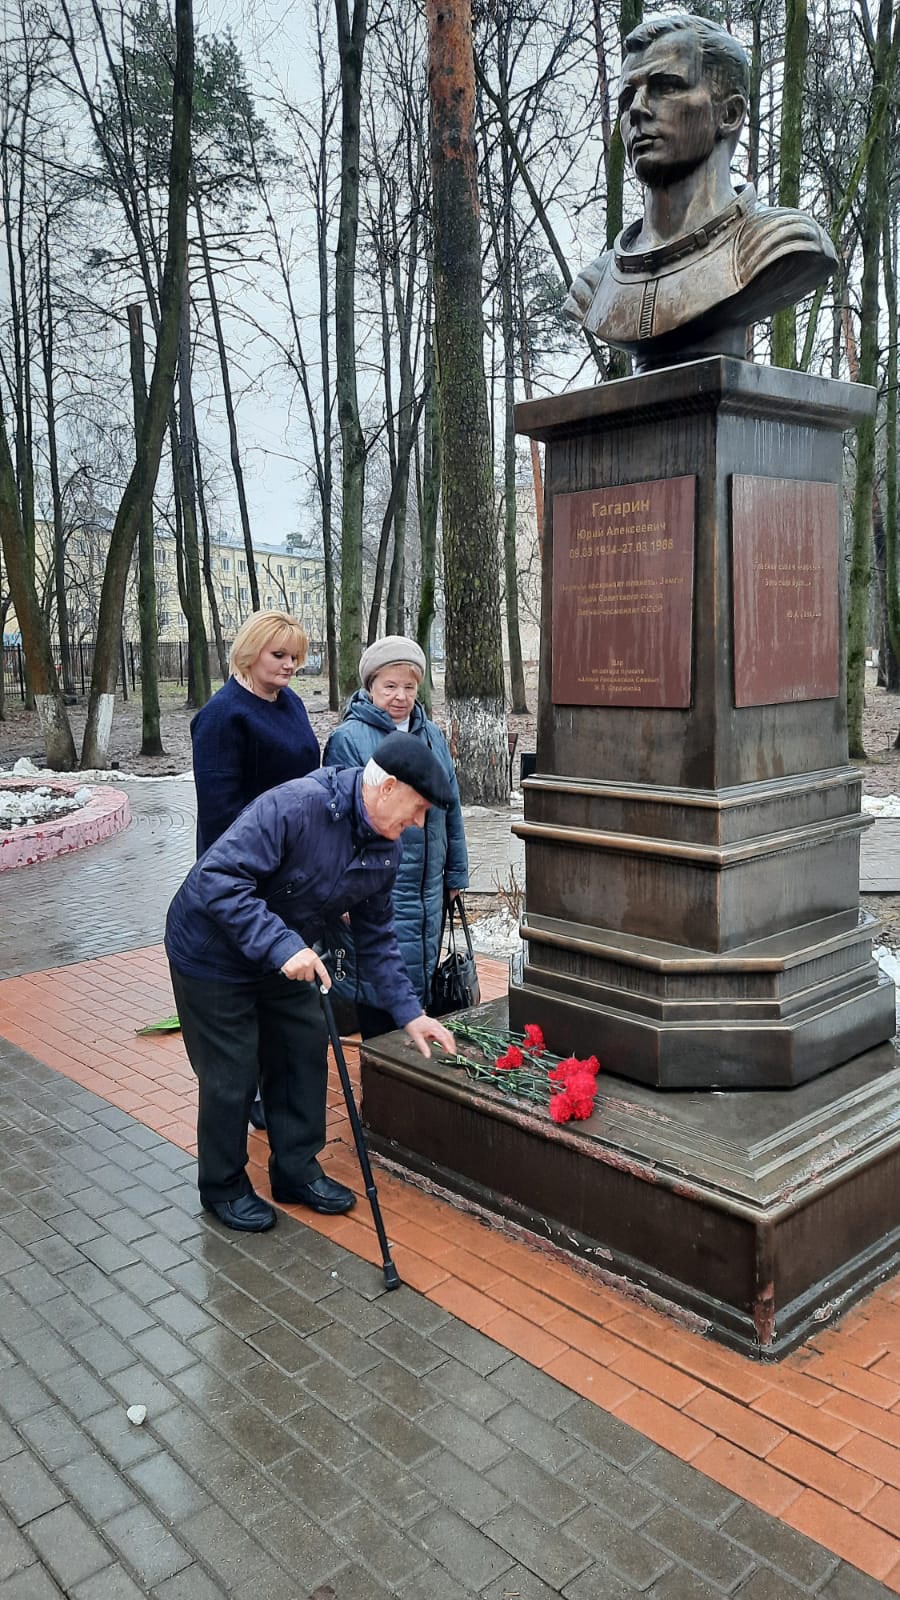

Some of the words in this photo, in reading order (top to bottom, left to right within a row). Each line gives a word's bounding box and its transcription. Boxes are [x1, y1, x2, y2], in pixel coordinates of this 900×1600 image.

[591, 500, 650, 517] Гагарин
[576, 527, 604, 540] Юрий
[606, 522, 666, 537] Алексеевич
